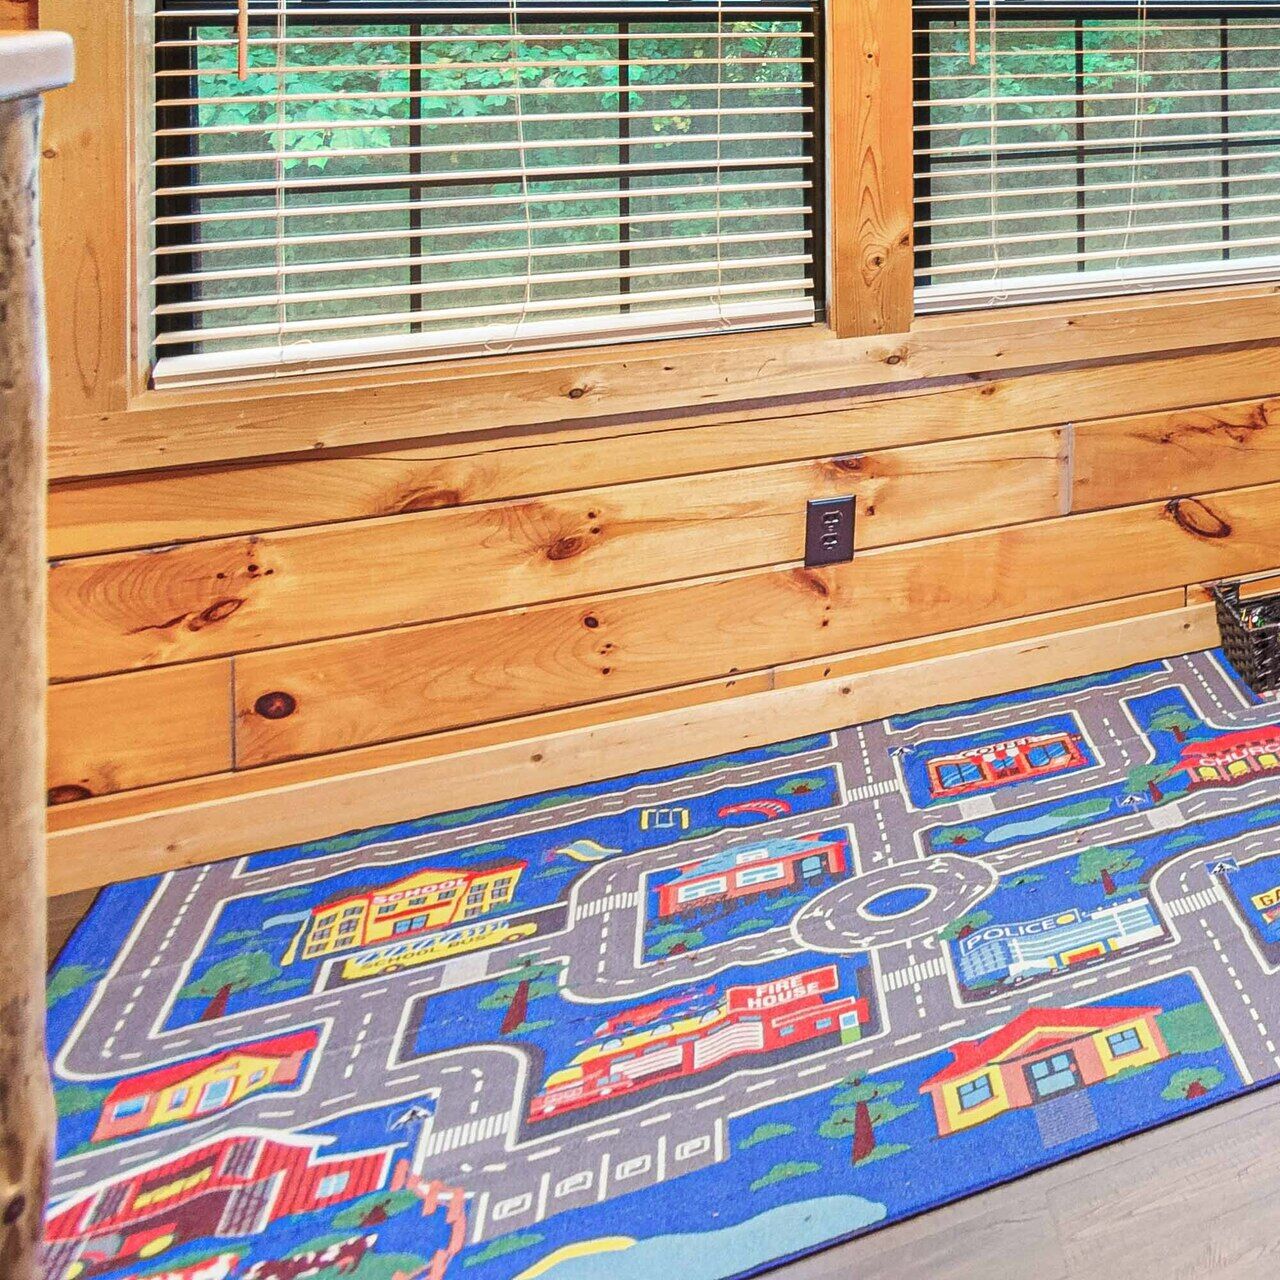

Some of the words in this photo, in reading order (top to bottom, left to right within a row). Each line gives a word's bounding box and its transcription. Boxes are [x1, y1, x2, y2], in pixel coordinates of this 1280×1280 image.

[372, 877, 469, 905] SCHOOL
[966, 919, 1057, 951] POLICE
[361, 946, 437, 969] SCHOOL
[747, 981, 820, 1009] HOUSE
[756, 974, 804, 998] FIRE
